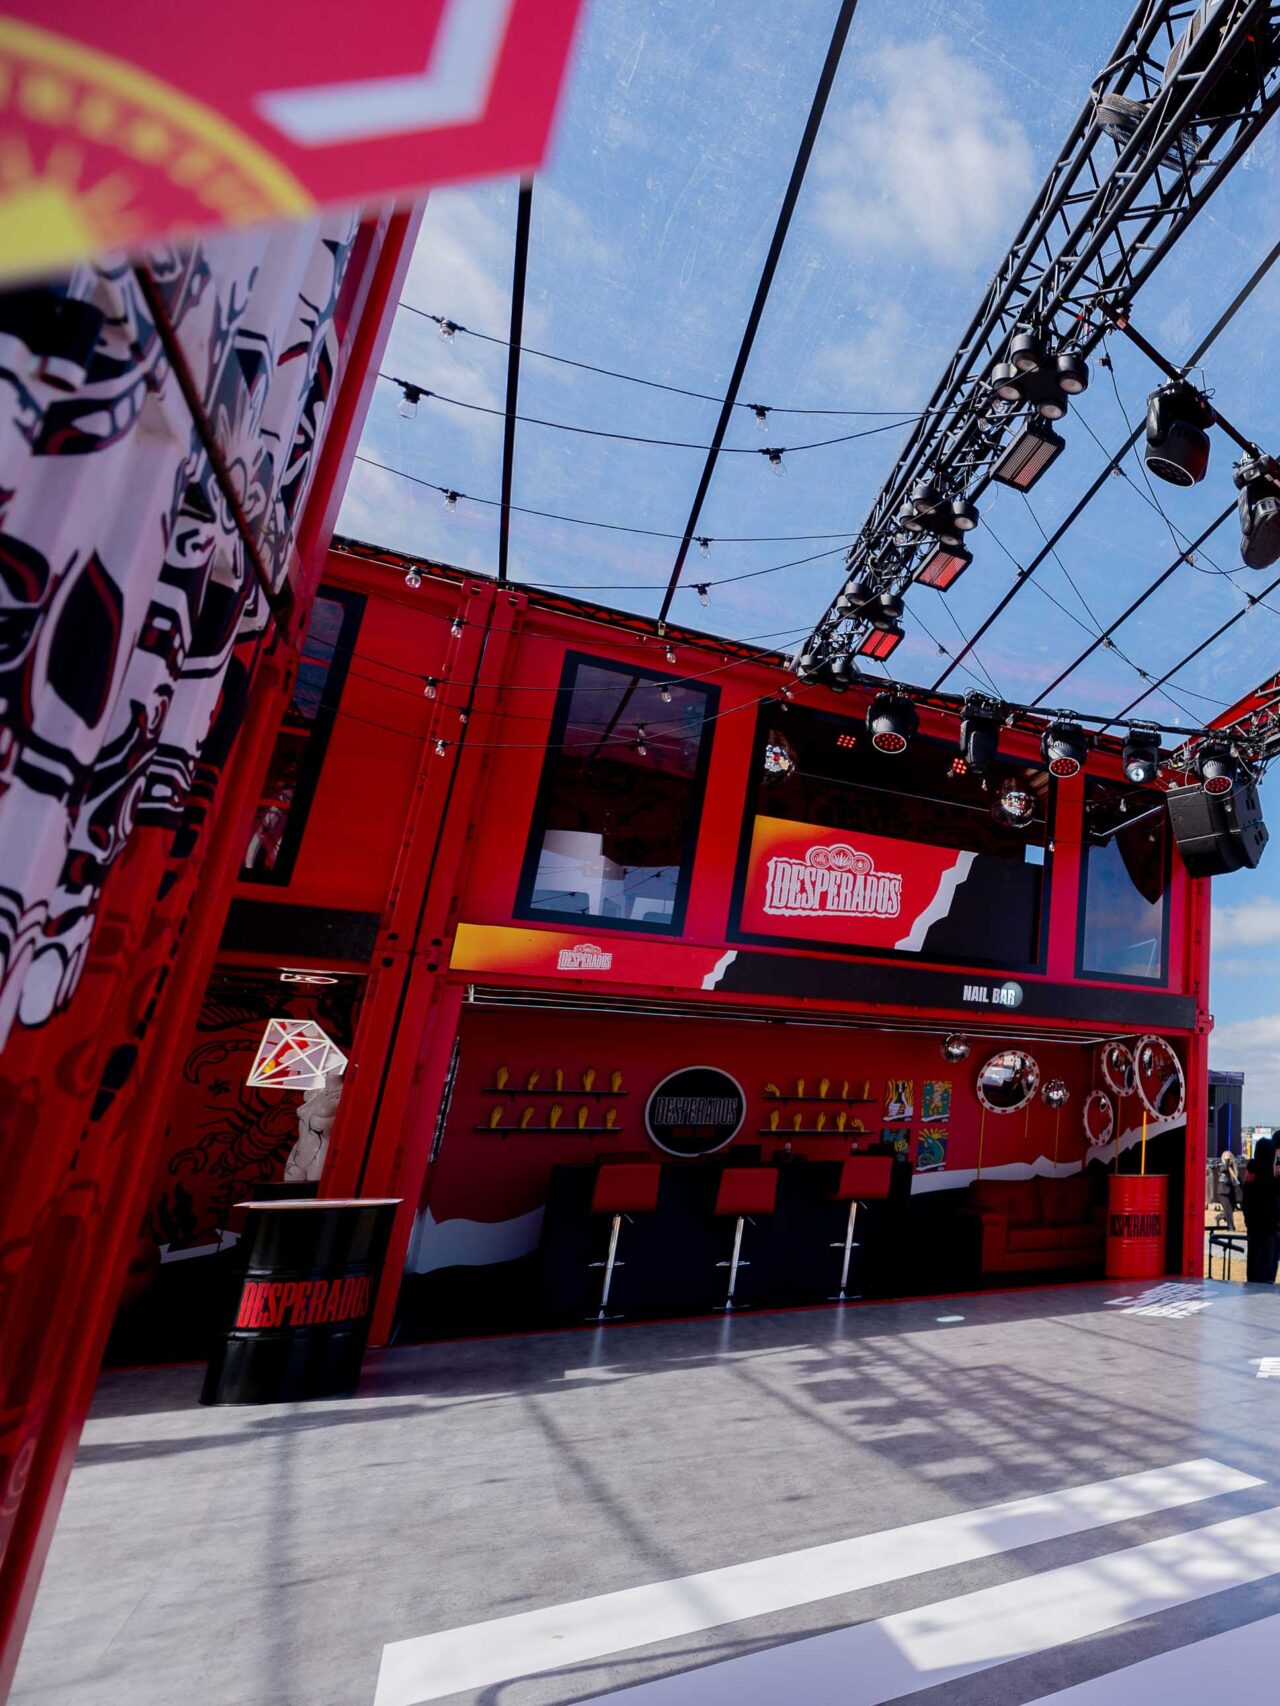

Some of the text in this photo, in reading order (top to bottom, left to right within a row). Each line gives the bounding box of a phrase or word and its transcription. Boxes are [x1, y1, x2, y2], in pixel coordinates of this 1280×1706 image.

[771, 861, 900, 914] DESPERADOS
[559, 950, 612, 969] DESPERADOS
[963, 985, 1016, 1006] NAIL BAR
[655, 1096, 739, 1125] DESPERADOS
[236, 1275, 374, 1329] DESPERADOS
